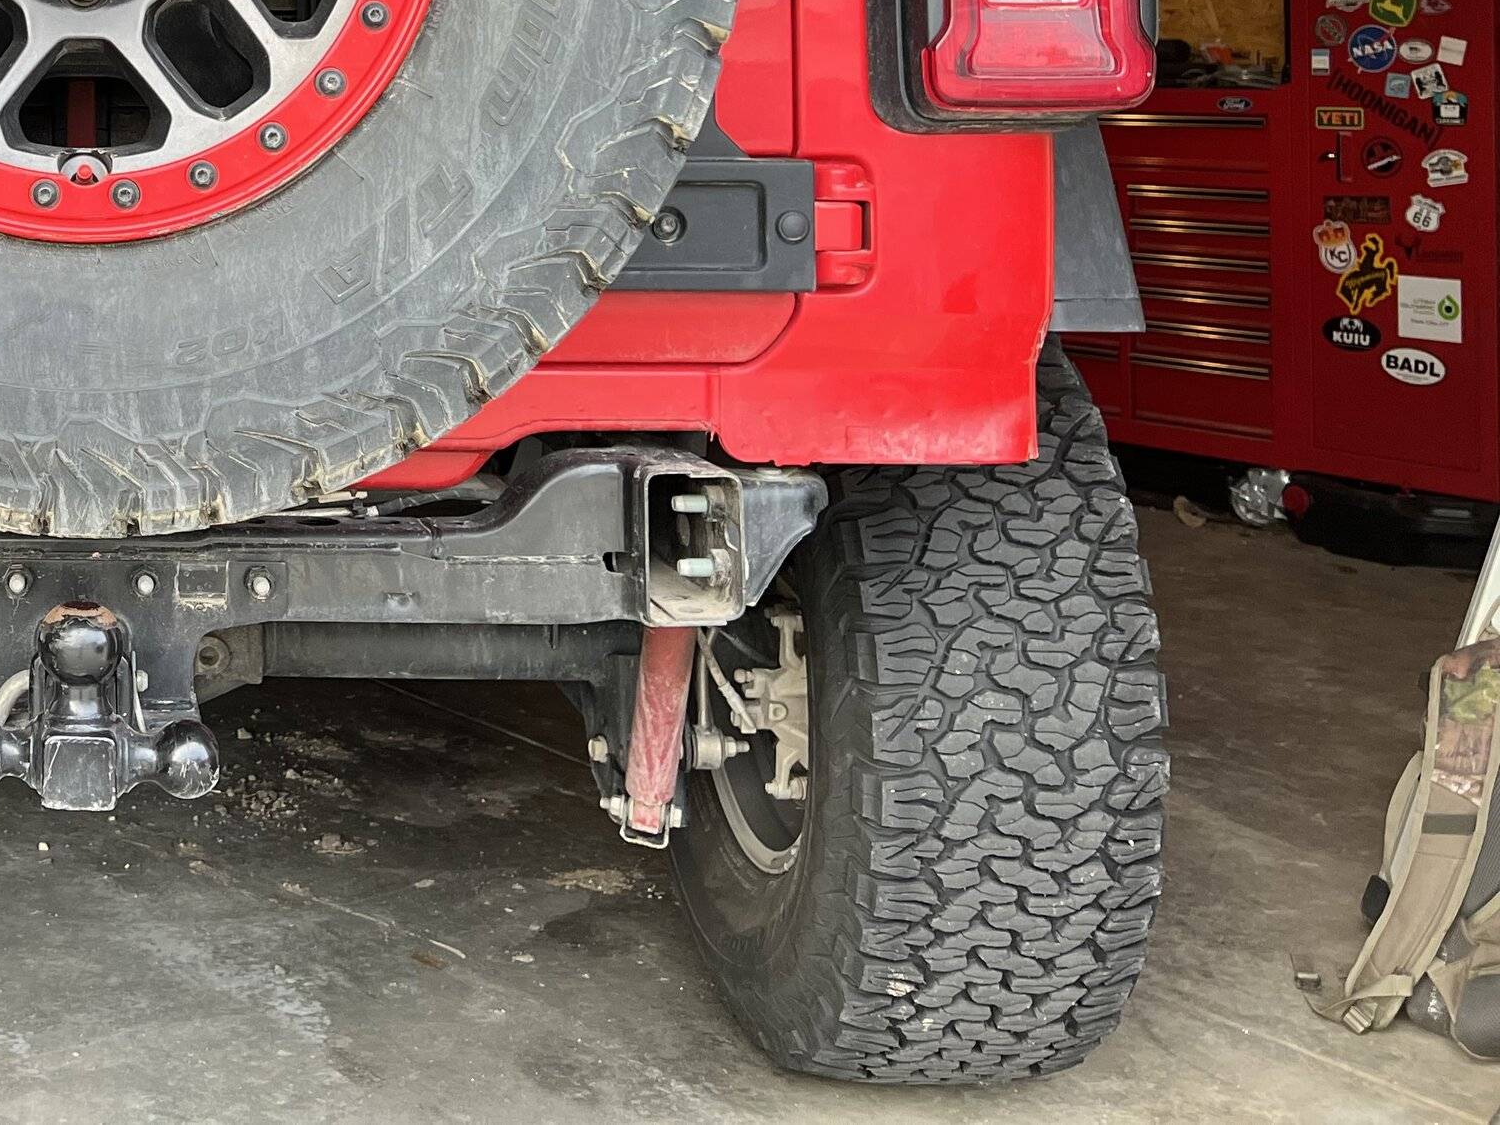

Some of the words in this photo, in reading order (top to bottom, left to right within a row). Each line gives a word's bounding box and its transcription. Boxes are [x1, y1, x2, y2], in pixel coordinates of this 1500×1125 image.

[1352, 40, 1393, 57] NASA
[1318, 112, 1360, 125] YETI
[1412, 211, 1432, 228] 66
[1329, 248, 1348, 264] KC
[1332, 331, 1371, 346] KUIU
[1386, 354, 1441, 377] BADL
